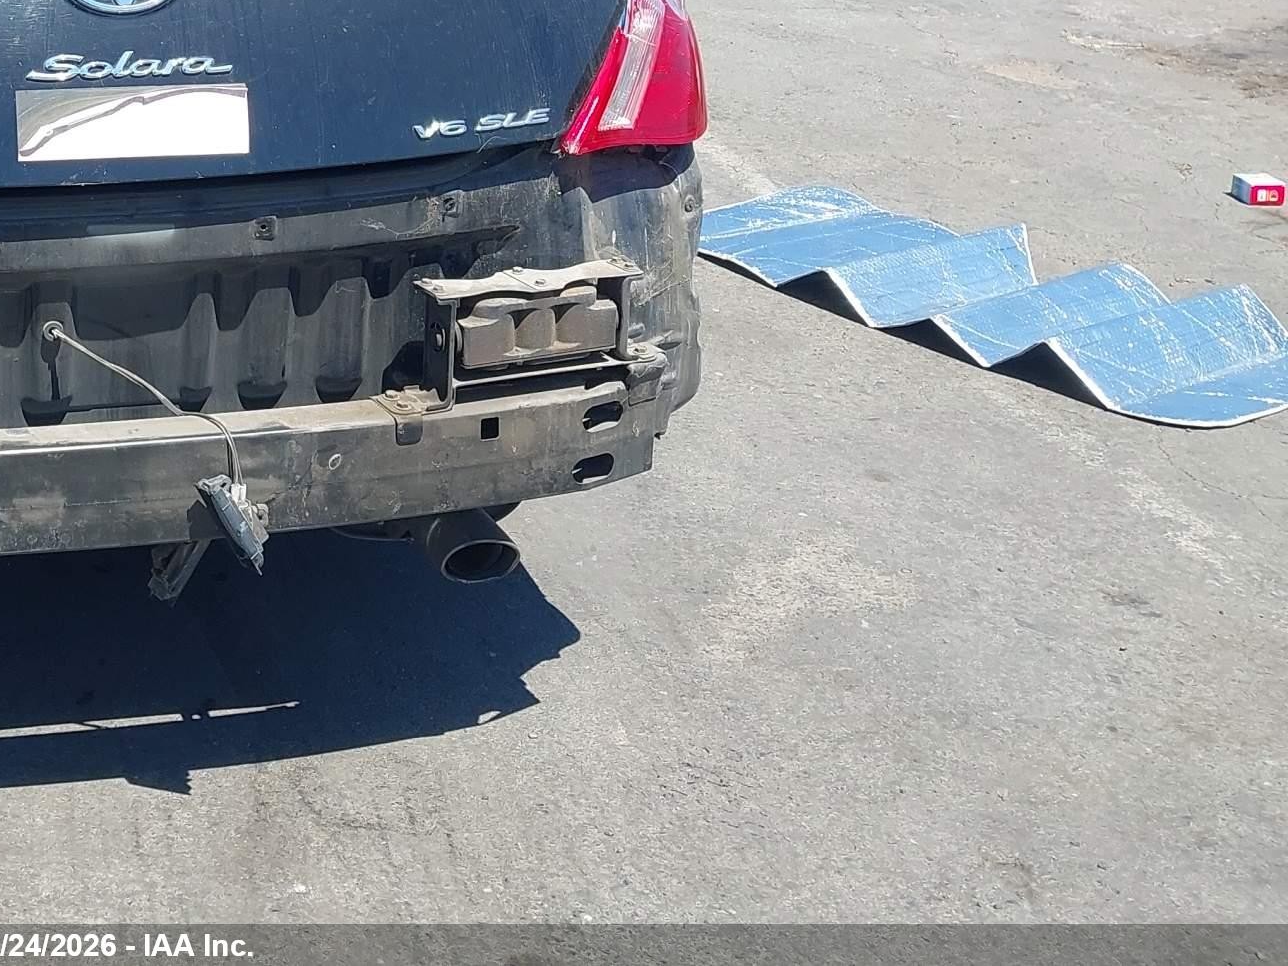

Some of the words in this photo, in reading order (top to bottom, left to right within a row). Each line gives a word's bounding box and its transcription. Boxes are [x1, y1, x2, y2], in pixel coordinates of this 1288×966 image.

[26, 50, 233, 82] Solara
[412, 119, 468, 139] V6
[474, 107, 551, 131] SLE
